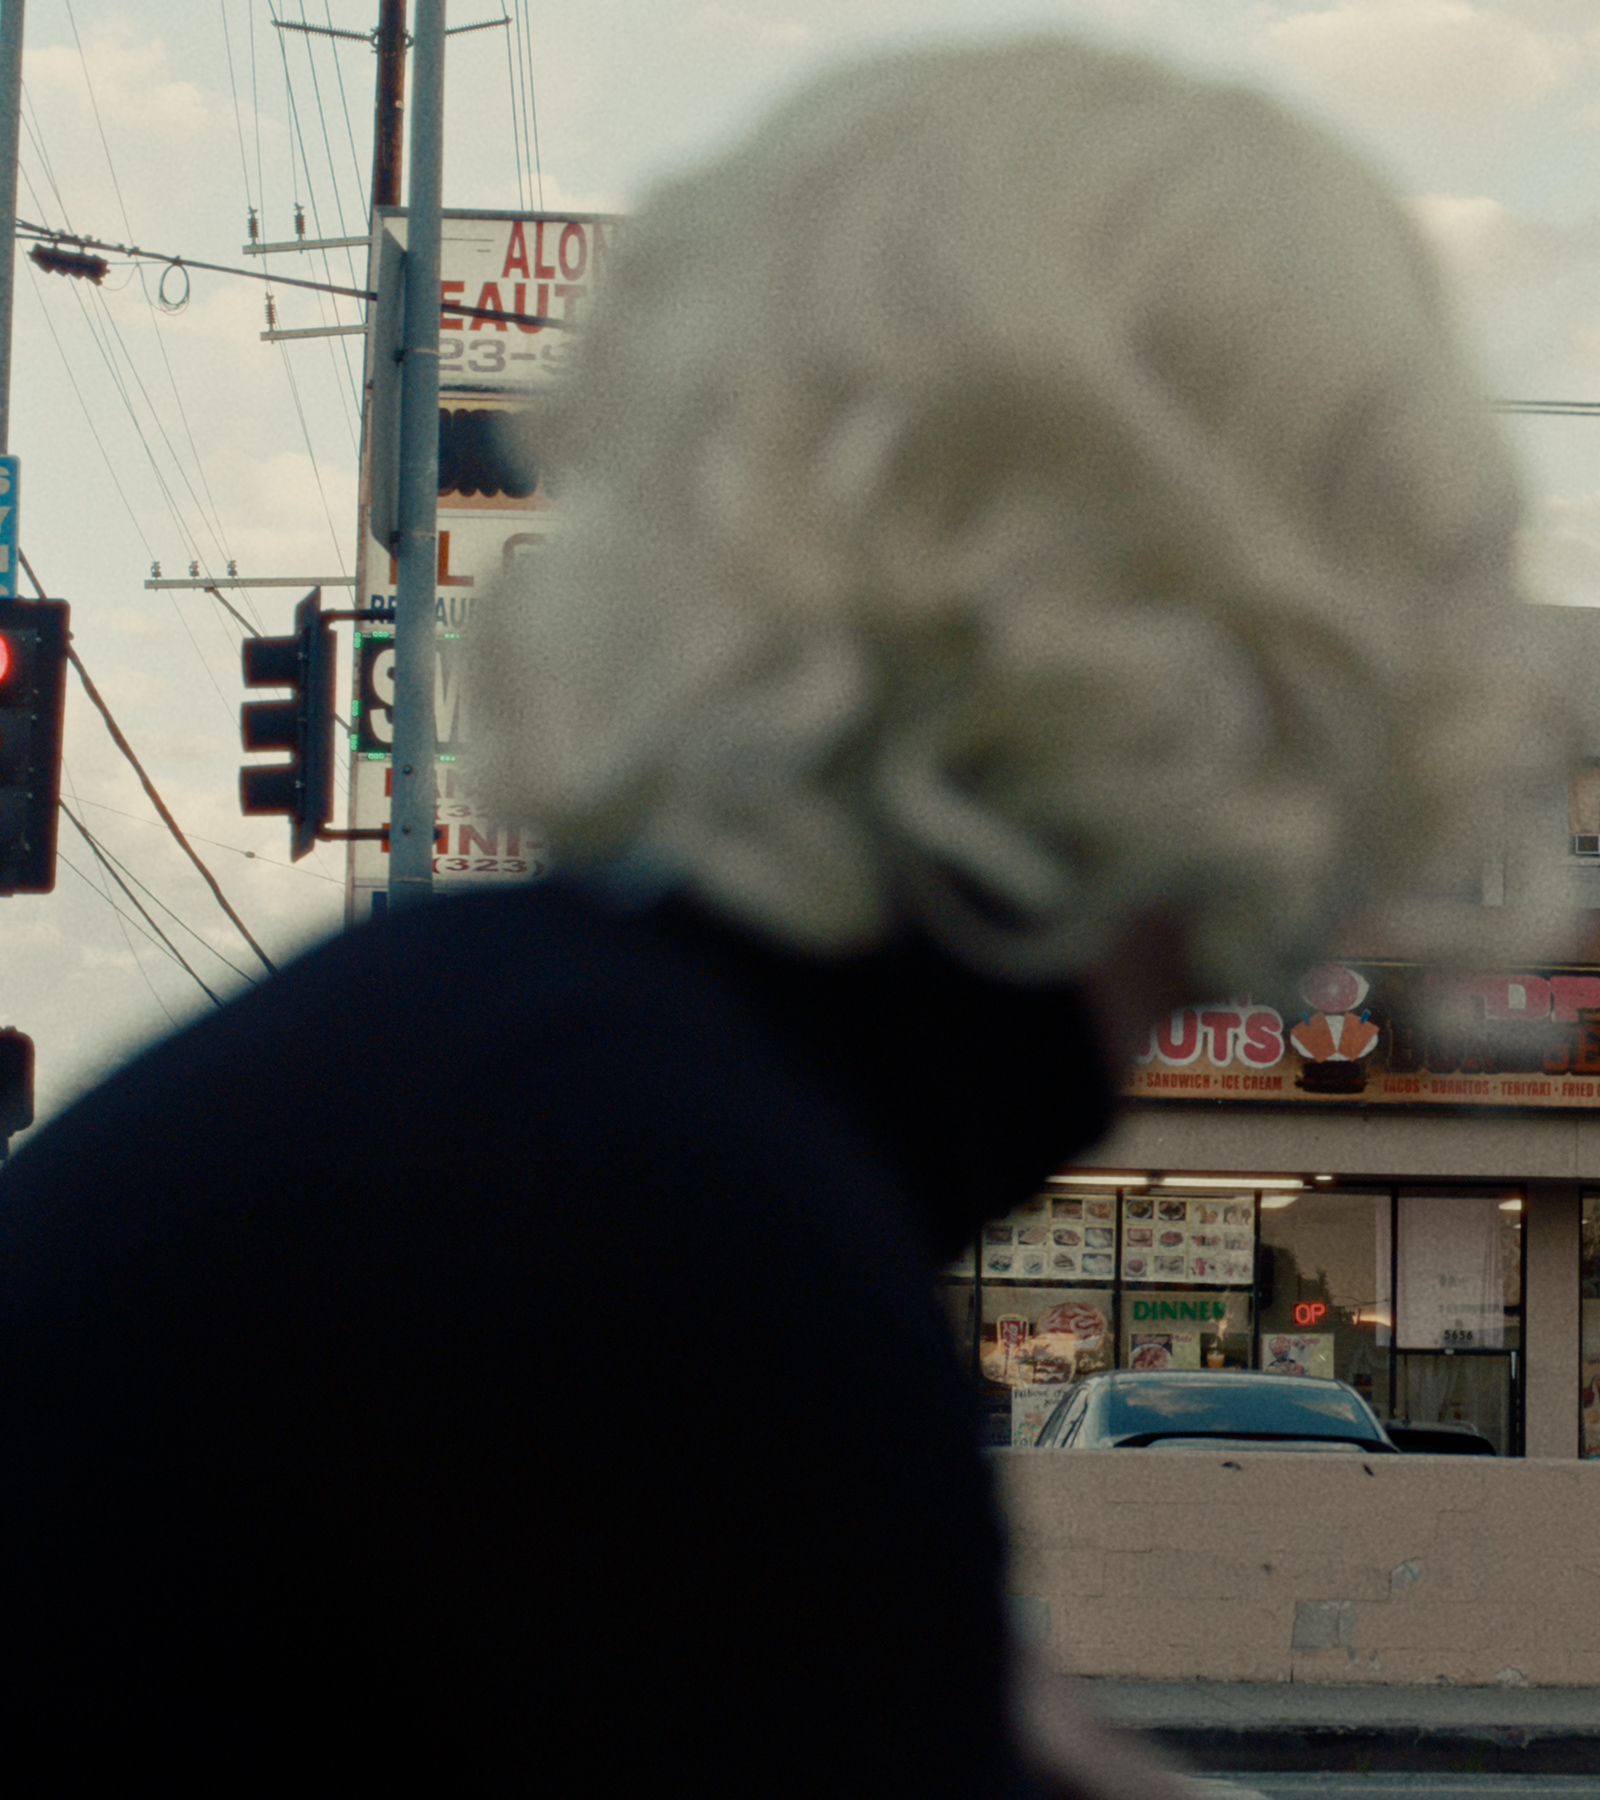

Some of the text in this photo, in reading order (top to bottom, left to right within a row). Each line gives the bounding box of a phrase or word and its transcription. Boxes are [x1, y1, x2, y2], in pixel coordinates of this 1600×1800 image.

[1146, 1072, 1210, 1090] SANDWICH
[1221, 1074, 1240, 1090] ICE
[1243, 1075, 1283, 1091] CREAM
[1501, 1081, 1552, 1097] TERIYAKI
[1562, 1082, 1594, 1098] FRIED
[1444, 1329, 1473, 1341] 5656
